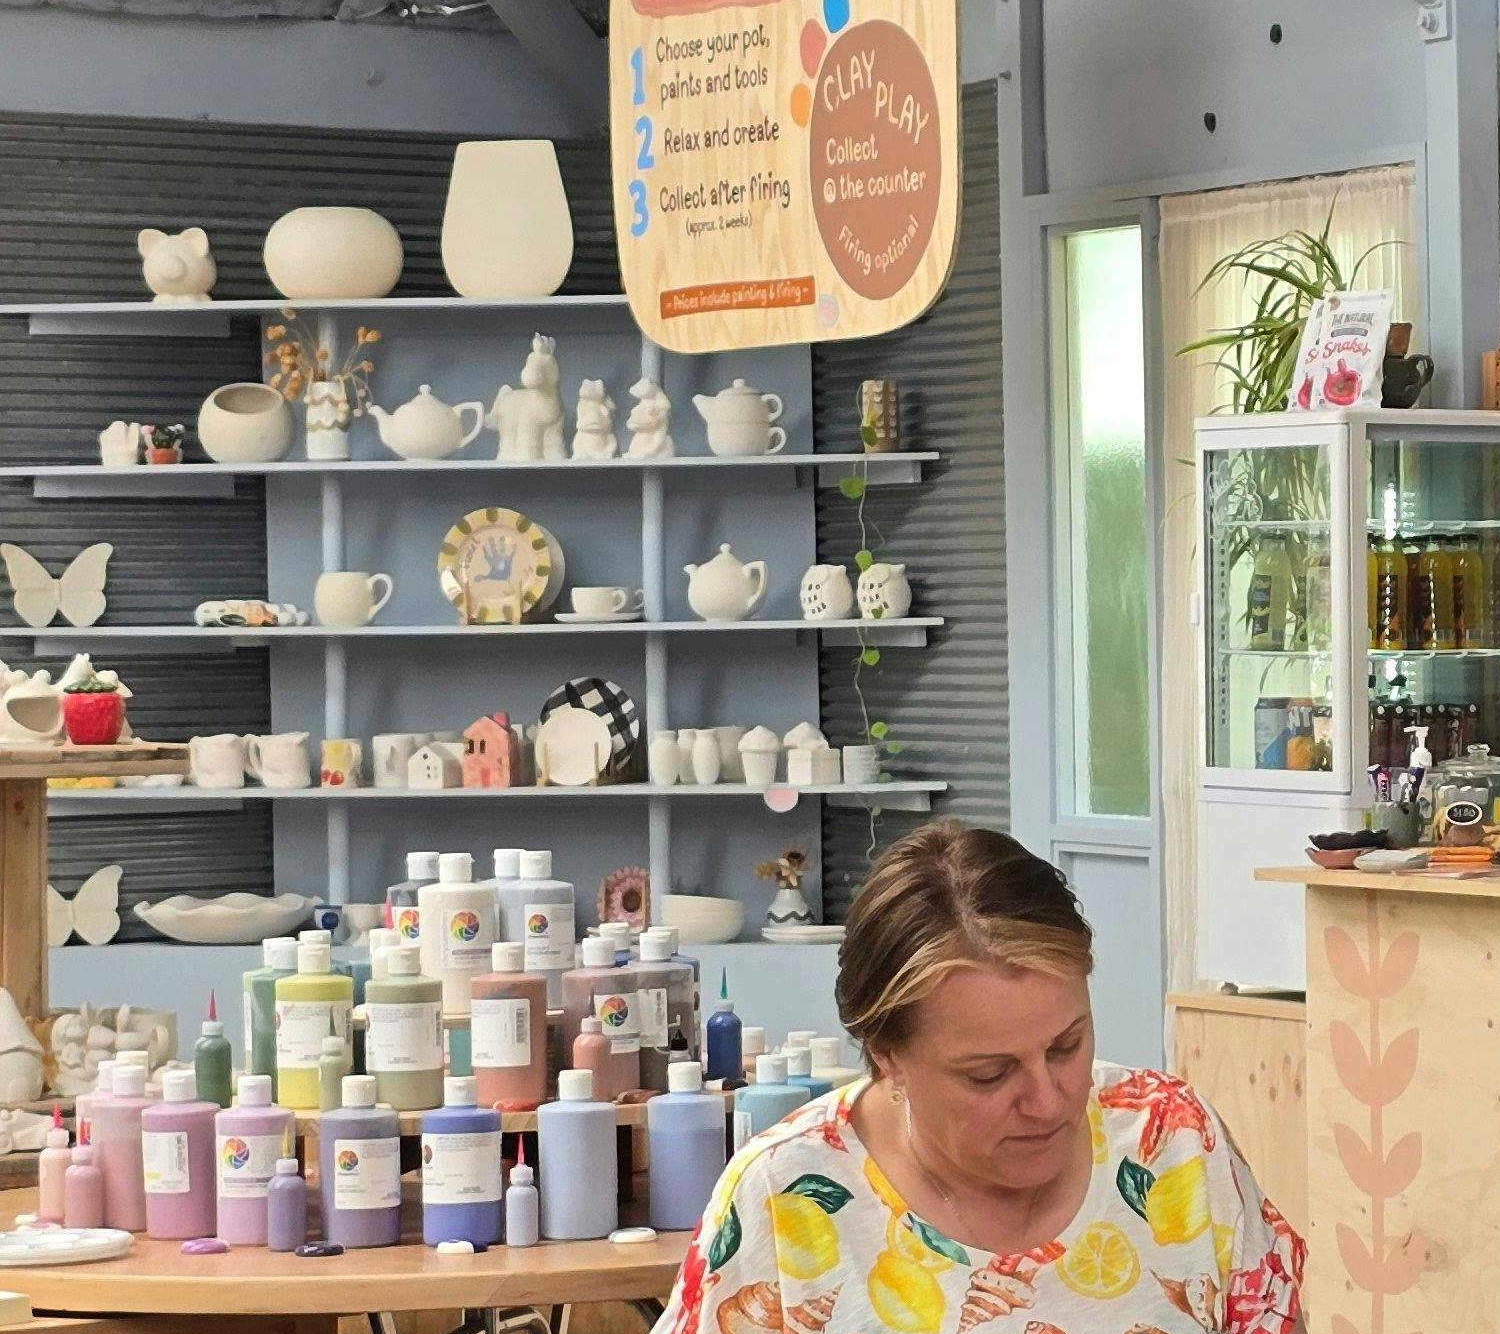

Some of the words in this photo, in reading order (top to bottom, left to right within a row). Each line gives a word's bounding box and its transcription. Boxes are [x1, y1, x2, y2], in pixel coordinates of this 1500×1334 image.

[656, 37, 703, 63] Choose
[707, 32, 738, 63] your
[742, 24, 770, 59] pot,
[631, 46, 645, 105] 1
[660, 70, 701, 109] paints
[706, 63, 731, 93] and
[735, 60, 768, 89] tools
[823, 48, 876, 112] CLAY
[664, 127, 700, 156] Relax
[704, 119, 729, 149] and
[733, 115, 780, 145] create
[875, 80, 929, 145] PLAY
[635, 115, 655, 170] 2
[825, 133, 879, 166] Collect
[628, 179, 649, 237] 3
[659, 183, 706, 213] Collect
[710, 178, 746, 206] after
[750, 171, 791, 209] firing
[823, 177, 837, 204] @
[840, 173, 864, 200] the
[868, 166, 927, 197] counter
[838, 224, 872, 276] Firing
[874, 213, 920, 274] optional
[673, 293, 699, 310] Prices
[700, 288, 731, 307] include
[732, 284, 767, 307] painting
[776, 281, 802, 303] firing
